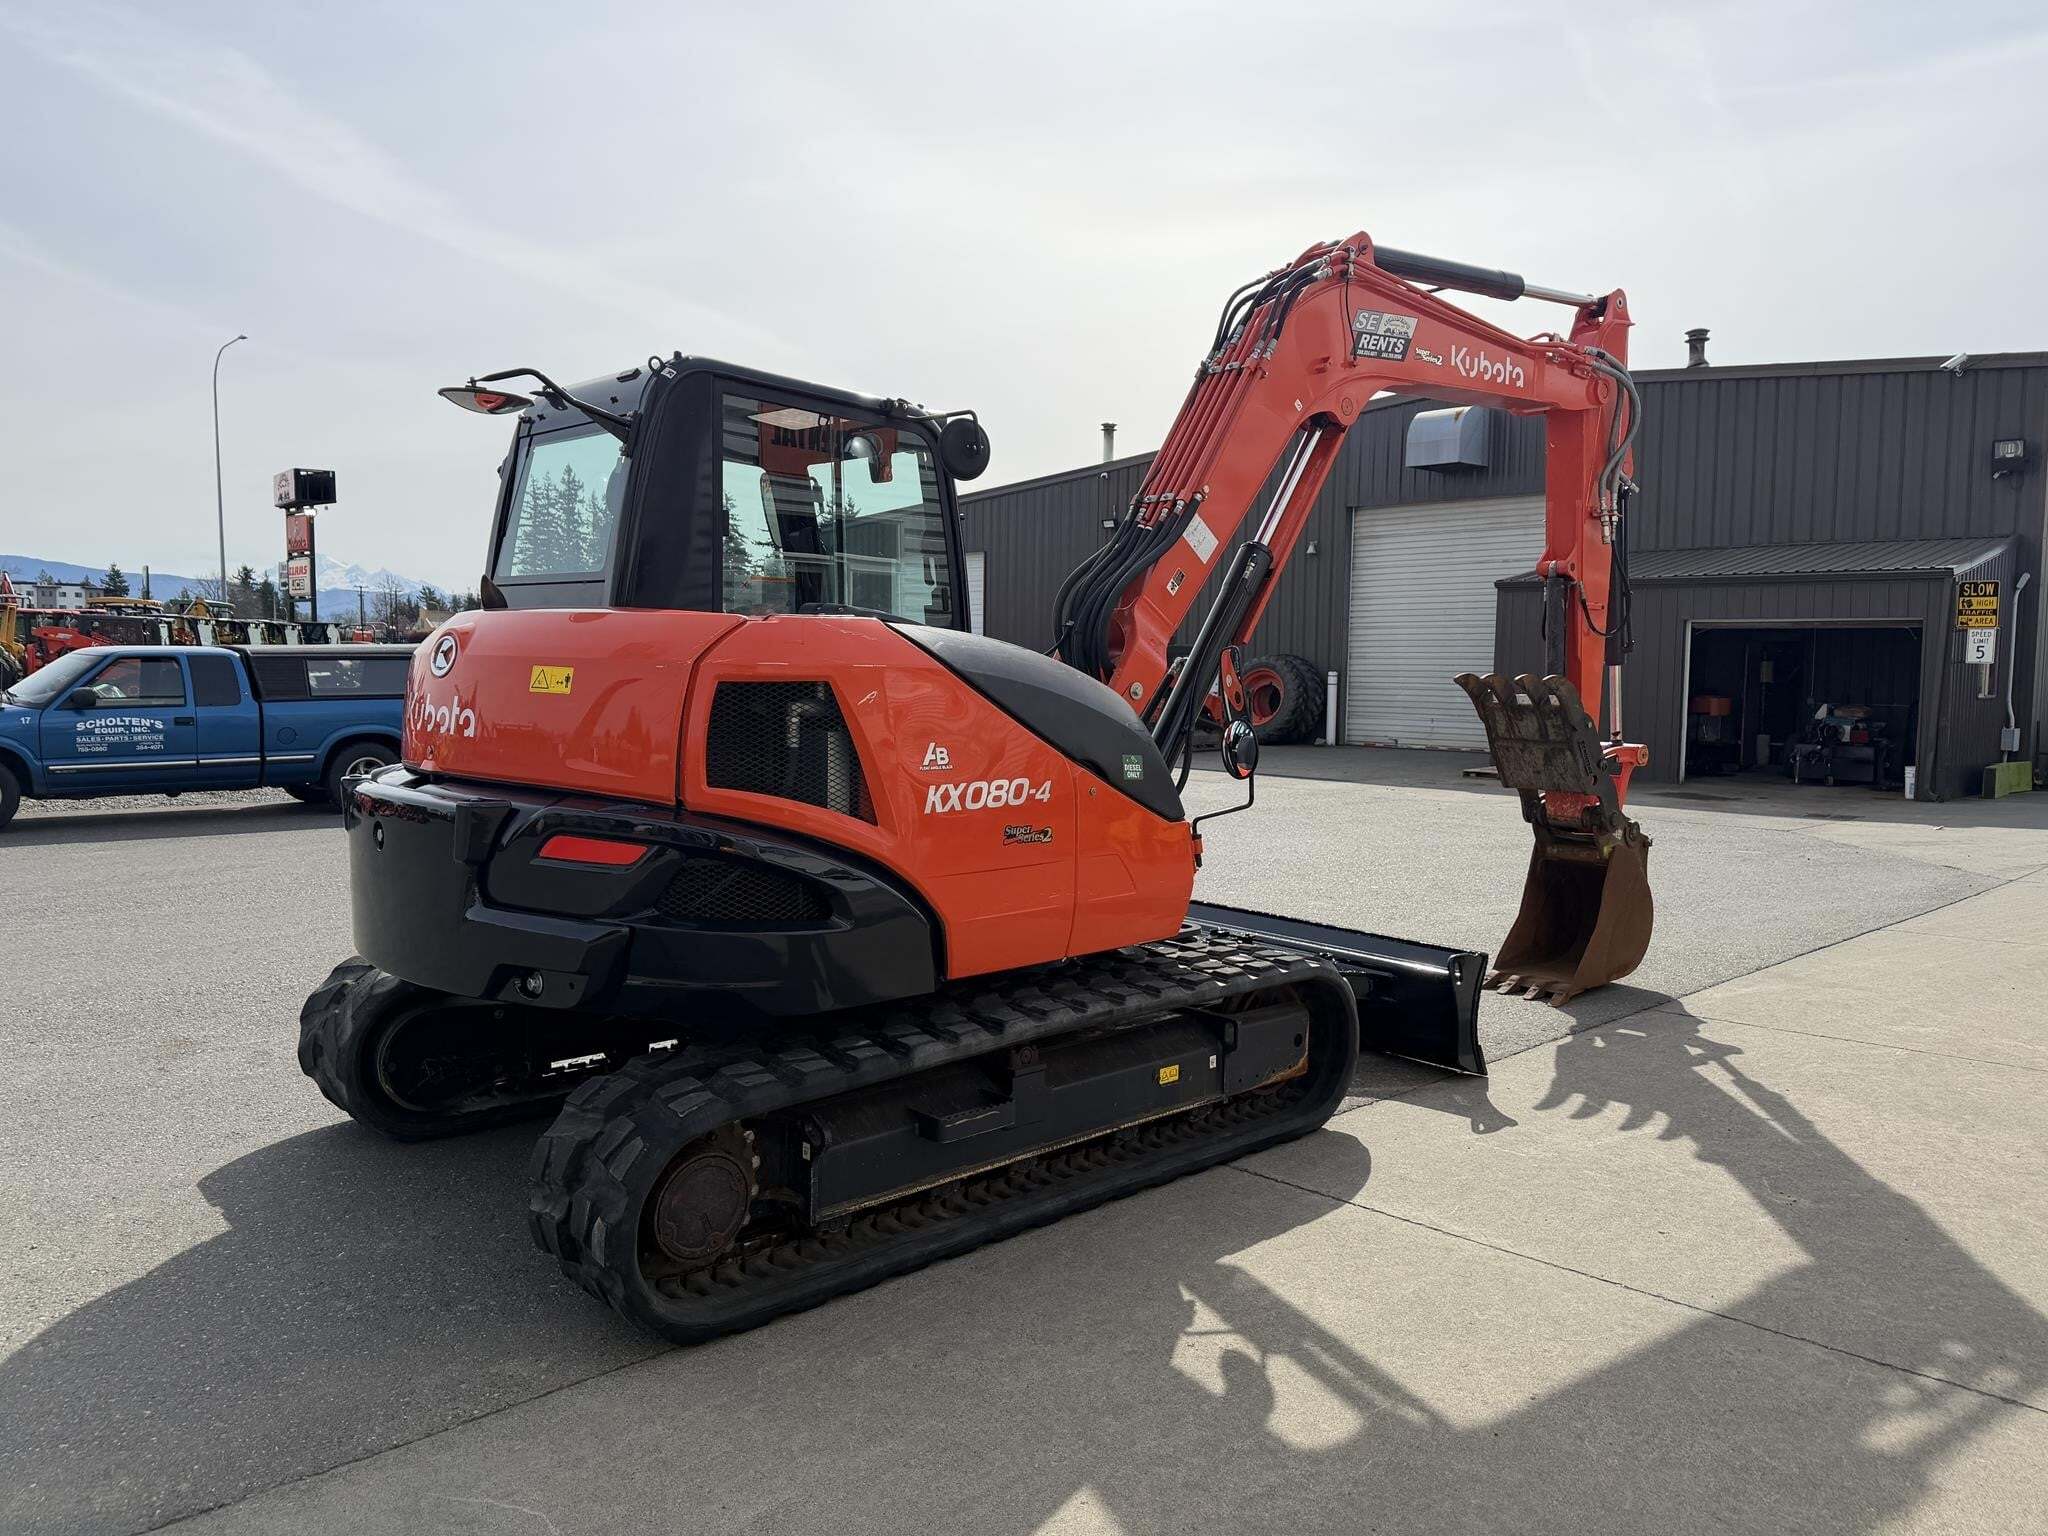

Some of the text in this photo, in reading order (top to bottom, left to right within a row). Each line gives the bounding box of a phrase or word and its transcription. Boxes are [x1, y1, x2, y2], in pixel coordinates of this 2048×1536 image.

[1355, 312, 1380, 330] SE
[1358, 333, 1405, 354] RENTS
[1451, 344, 1524, 388] Kubota
[1963, 583, 1995, 596] SLOW
[1975, 645, 1985, 660] 5
[20, 716, 32, 725] 17
[408, 690, 476, 738] Kubota
[76, 717, 164, 731] SCHOLTEN'S
[1124, 764, 1142, 772] DIESEL
[1126, 771, 1141, 779] ONLY
[924, 778, 1052, 815] KX080-4
[1004, 825, 1032, 837] Super
